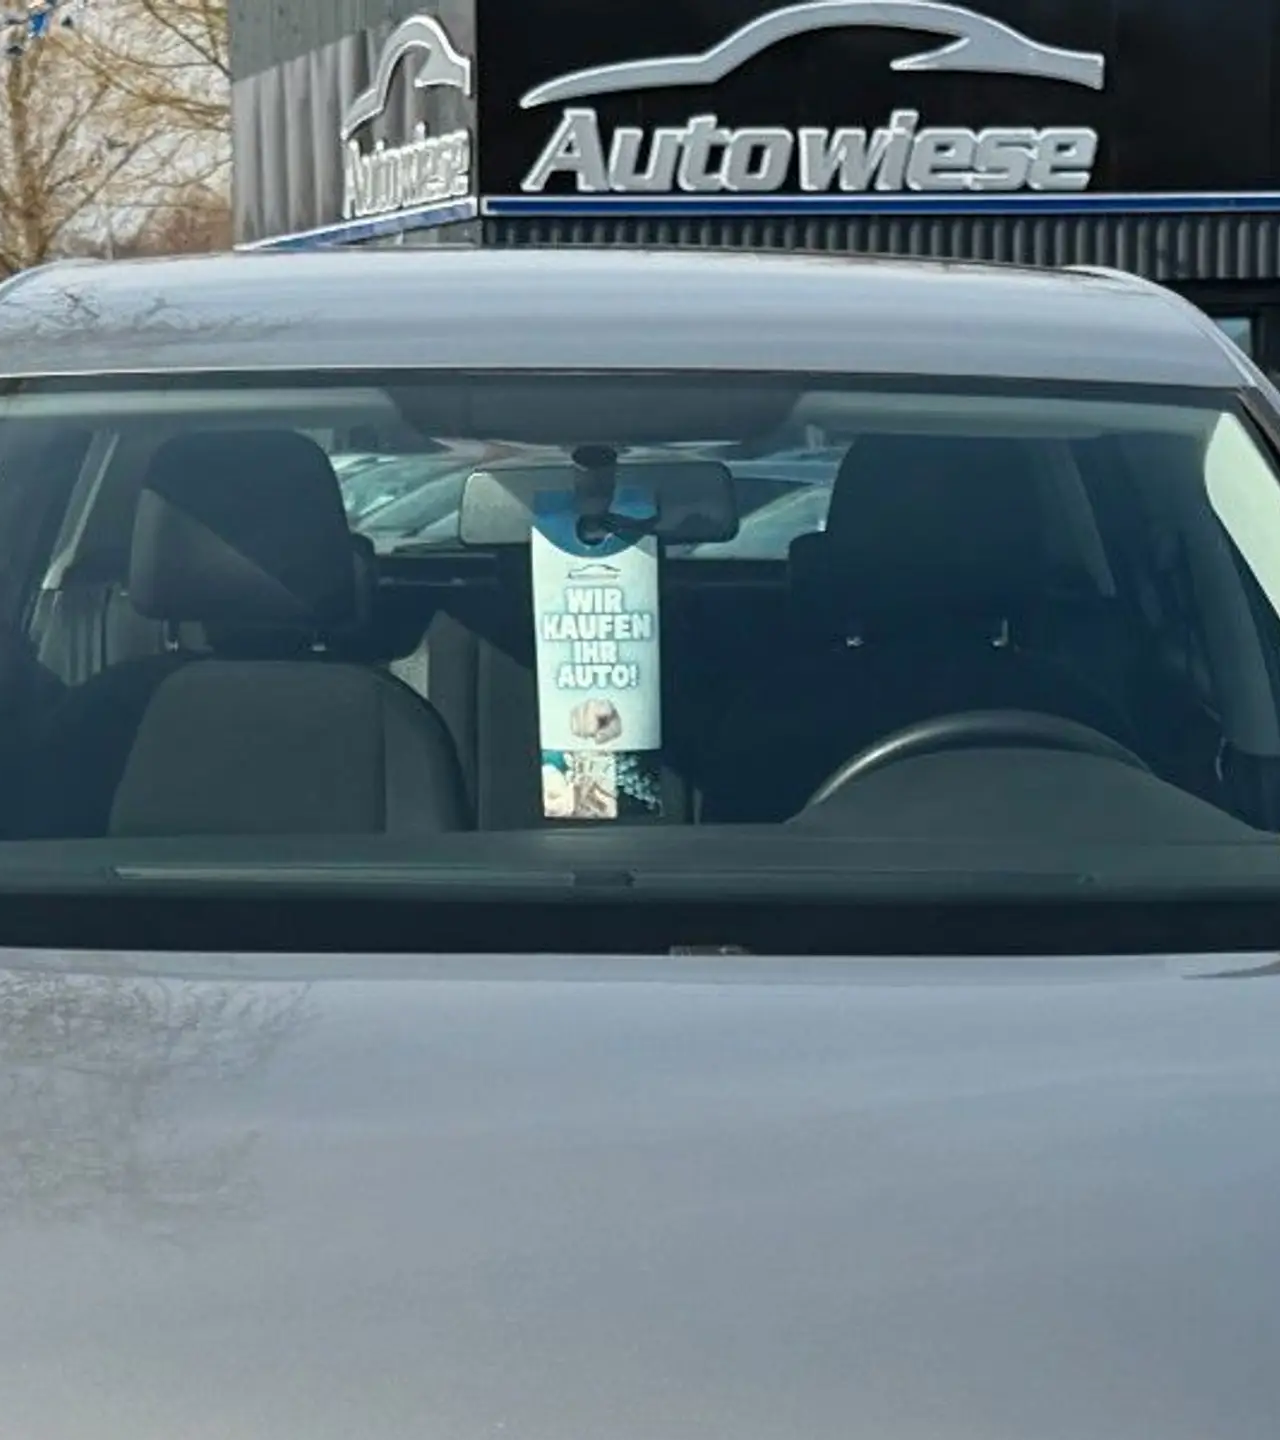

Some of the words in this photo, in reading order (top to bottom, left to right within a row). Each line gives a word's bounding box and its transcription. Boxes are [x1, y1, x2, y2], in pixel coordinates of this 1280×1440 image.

[520, 108, 1098, 192] Autowiese
[566, 588, 623, 614] WIR
[542, 613, 653, 640] KAUFEN
[573, 641, 618, 664] IHR
[558, 663, 638, 689] AUTO!
